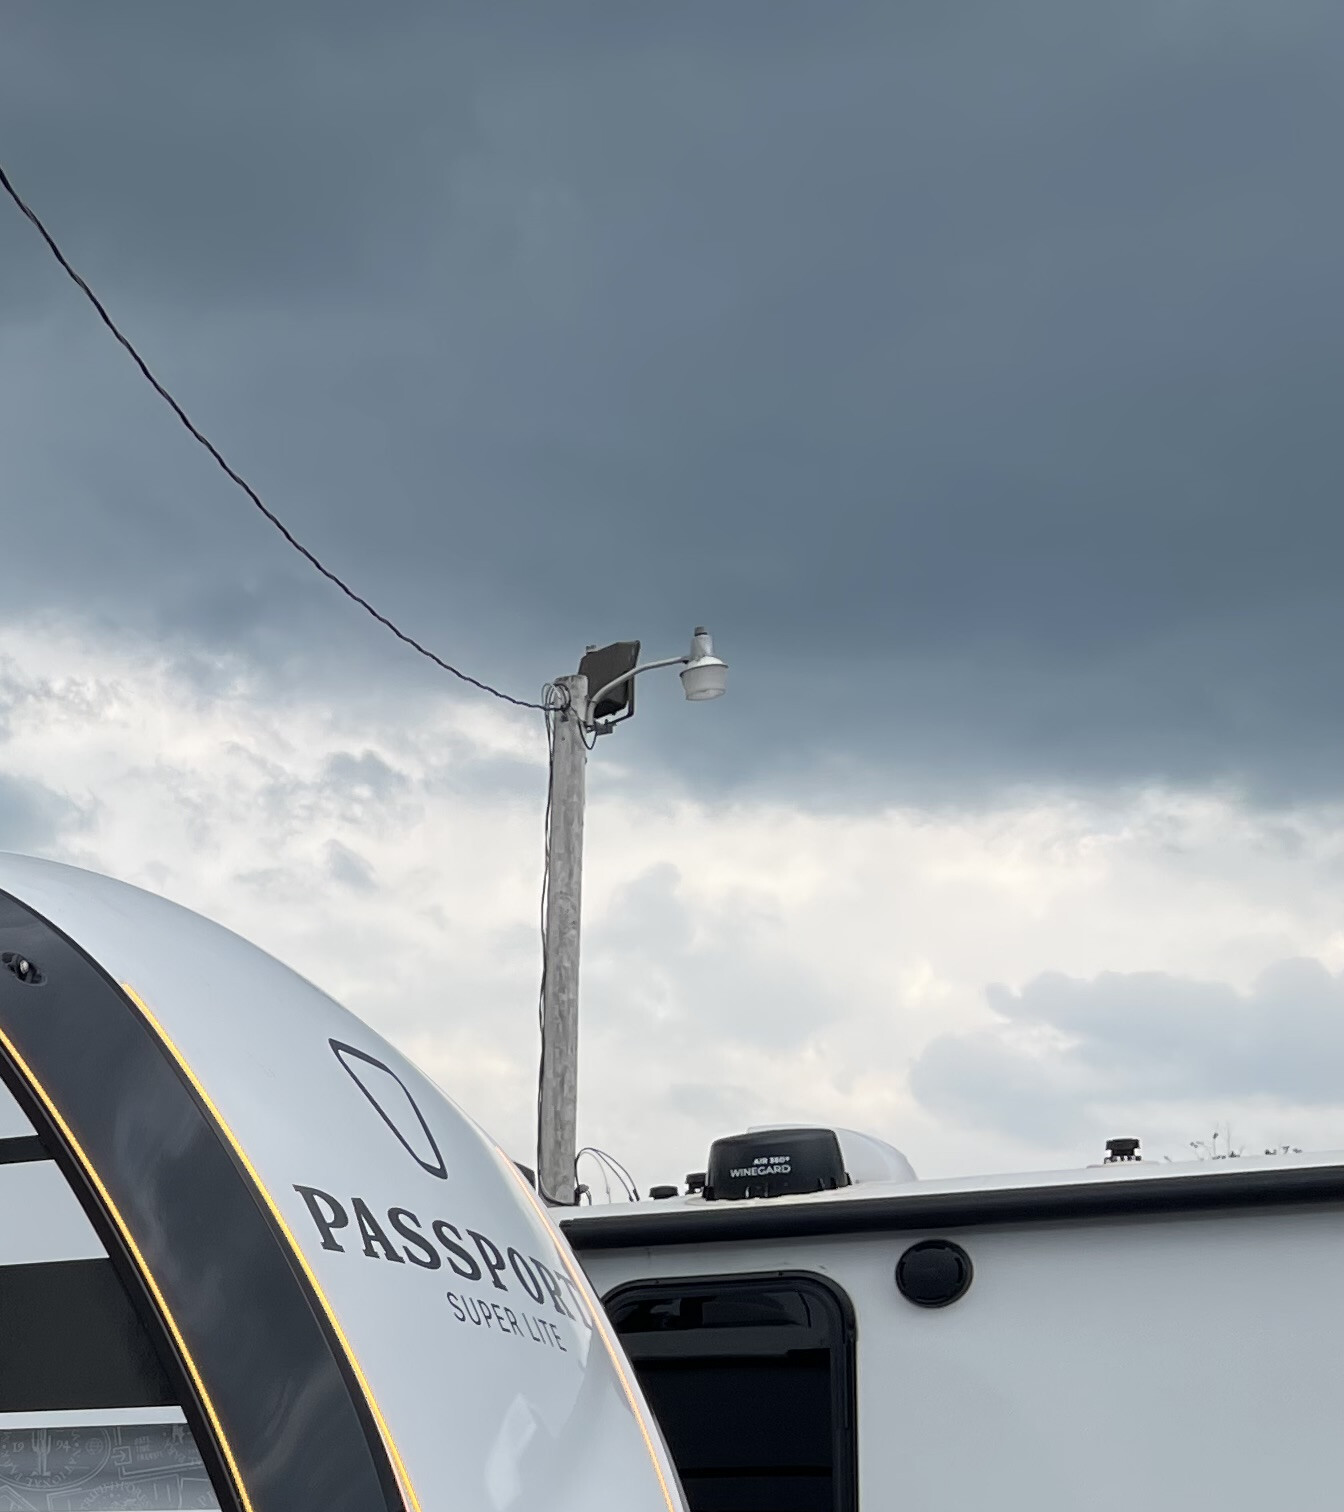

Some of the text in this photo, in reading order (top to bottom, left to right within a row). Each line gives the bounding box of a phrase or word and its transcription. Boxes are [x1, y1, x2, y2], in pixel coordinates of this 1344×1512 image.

[730, 1164, 791, 1178] WINEGARD
[753, 1157, 768, 1165] AIR
[292, 1184, 593, 1330] PASSPORT
[446, 1291, 567, 1353] SUPER LITE
